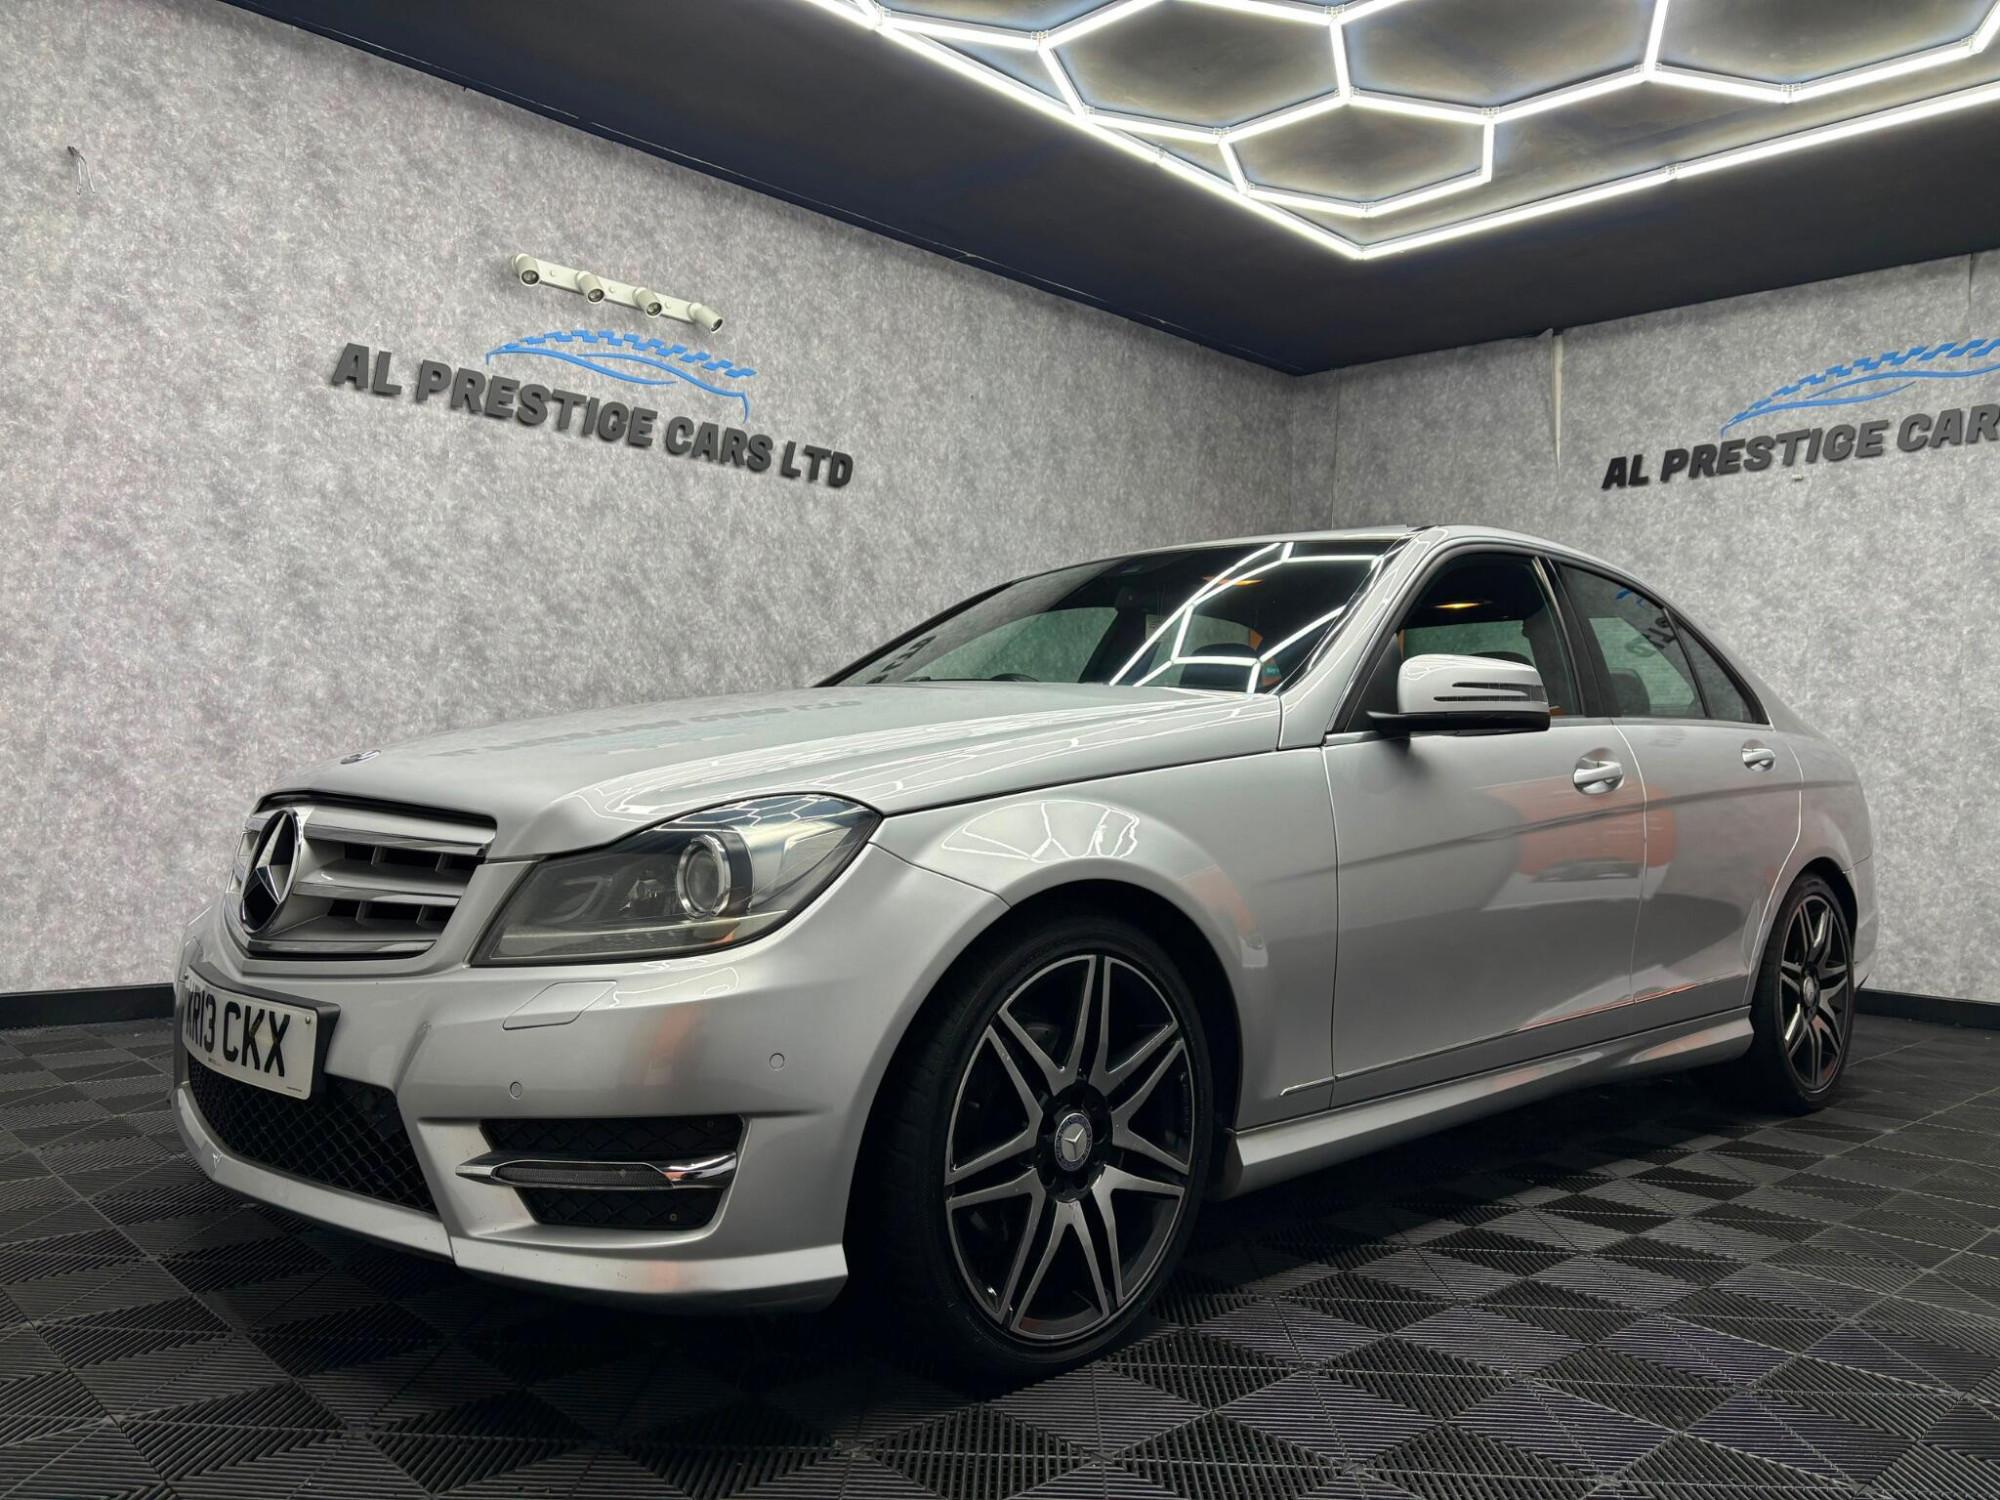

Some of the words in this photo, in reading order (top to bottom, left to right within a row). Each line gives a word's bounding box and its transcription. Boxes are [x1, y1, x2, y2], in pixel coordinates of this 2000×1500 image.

[332, 342, 402, 396] AL
[416, 360, 658, 447] PRESTIGE
[665, 415, 772, 471] CARS
[782, 441, 854, 487] LTD
[1602, 454, 1649, 489] AL
[1660, 420, 1890, 482] PRESTIGE
[223, 1001, 291, 1077] CKX
